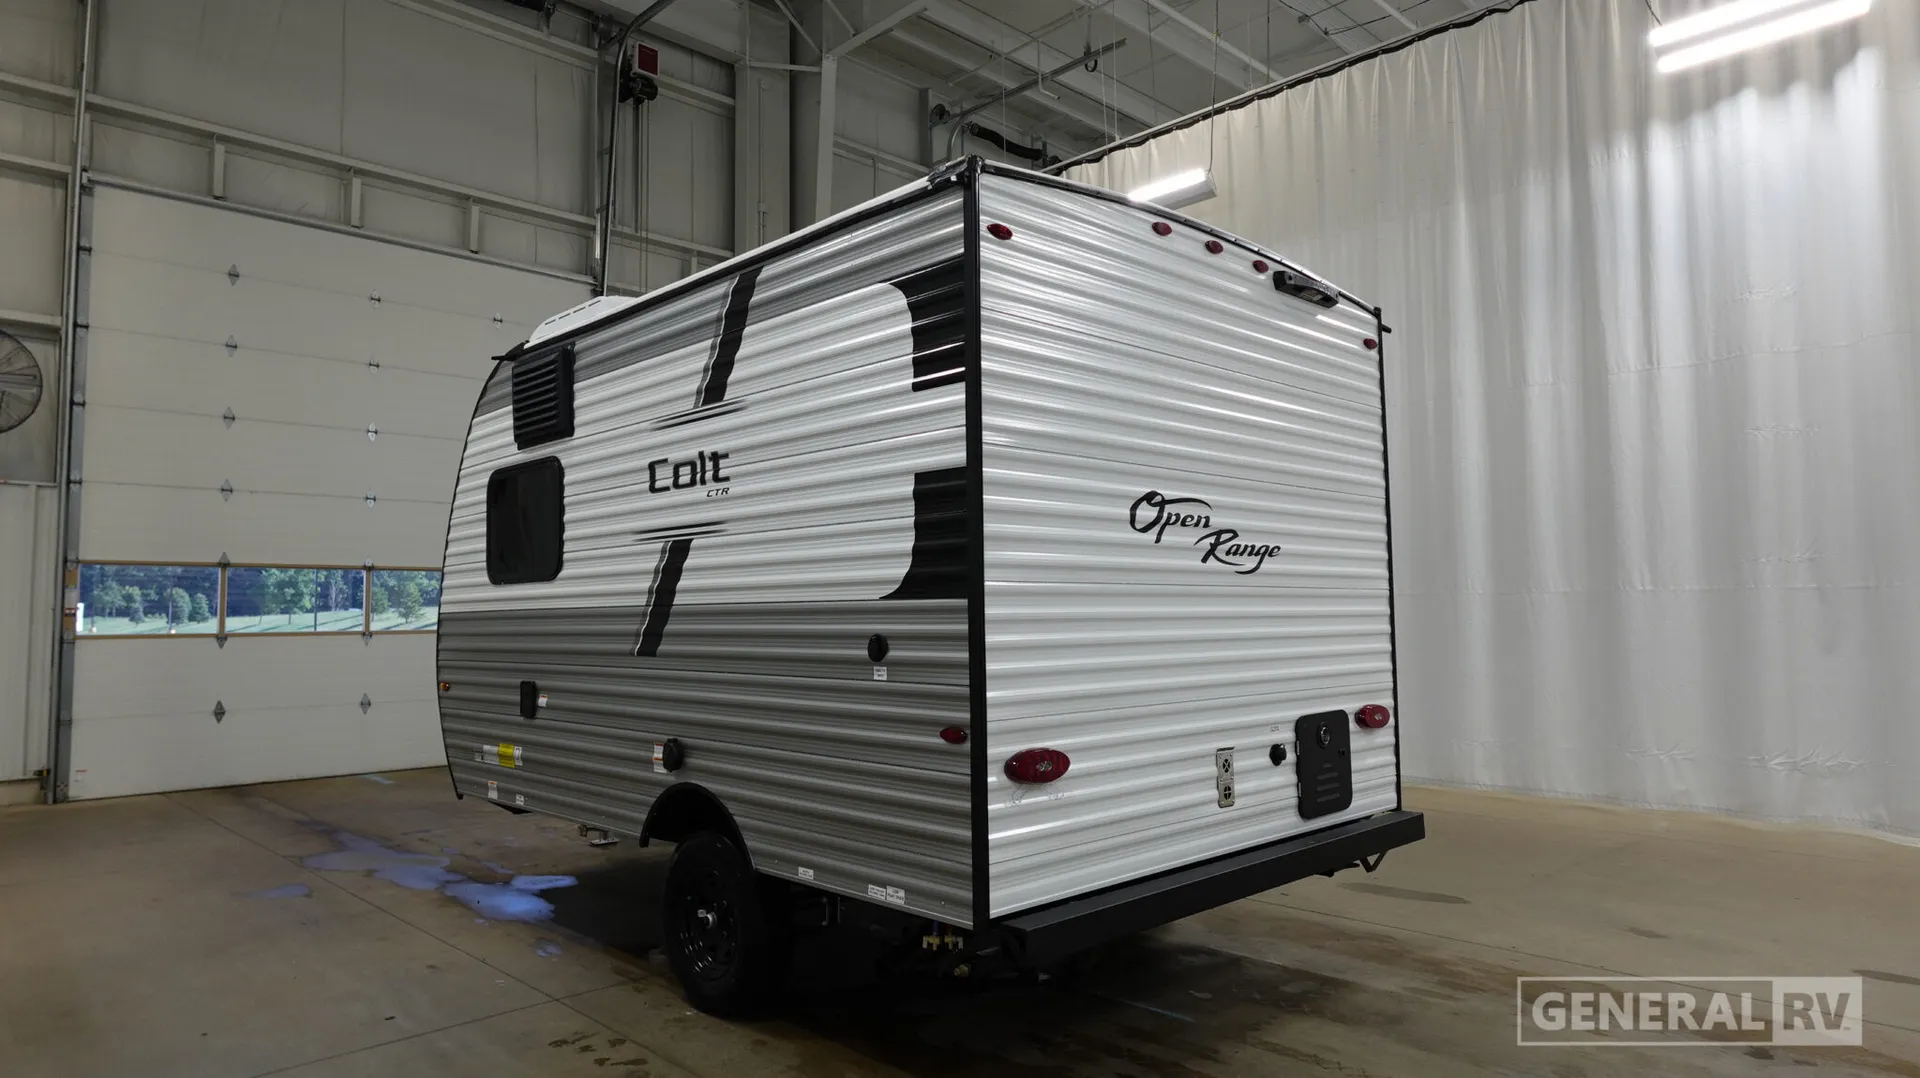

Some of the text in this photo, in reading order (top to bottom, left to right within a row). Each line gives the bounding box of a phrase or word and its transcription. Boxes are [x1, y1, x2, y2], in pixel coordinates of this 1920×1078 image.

[648, 450, 731, 494] Colt
[706, 487, 730, 498] CTR
[1129, 490, 1213, 544] Open
[1193, 528, 1281, 575] Range
